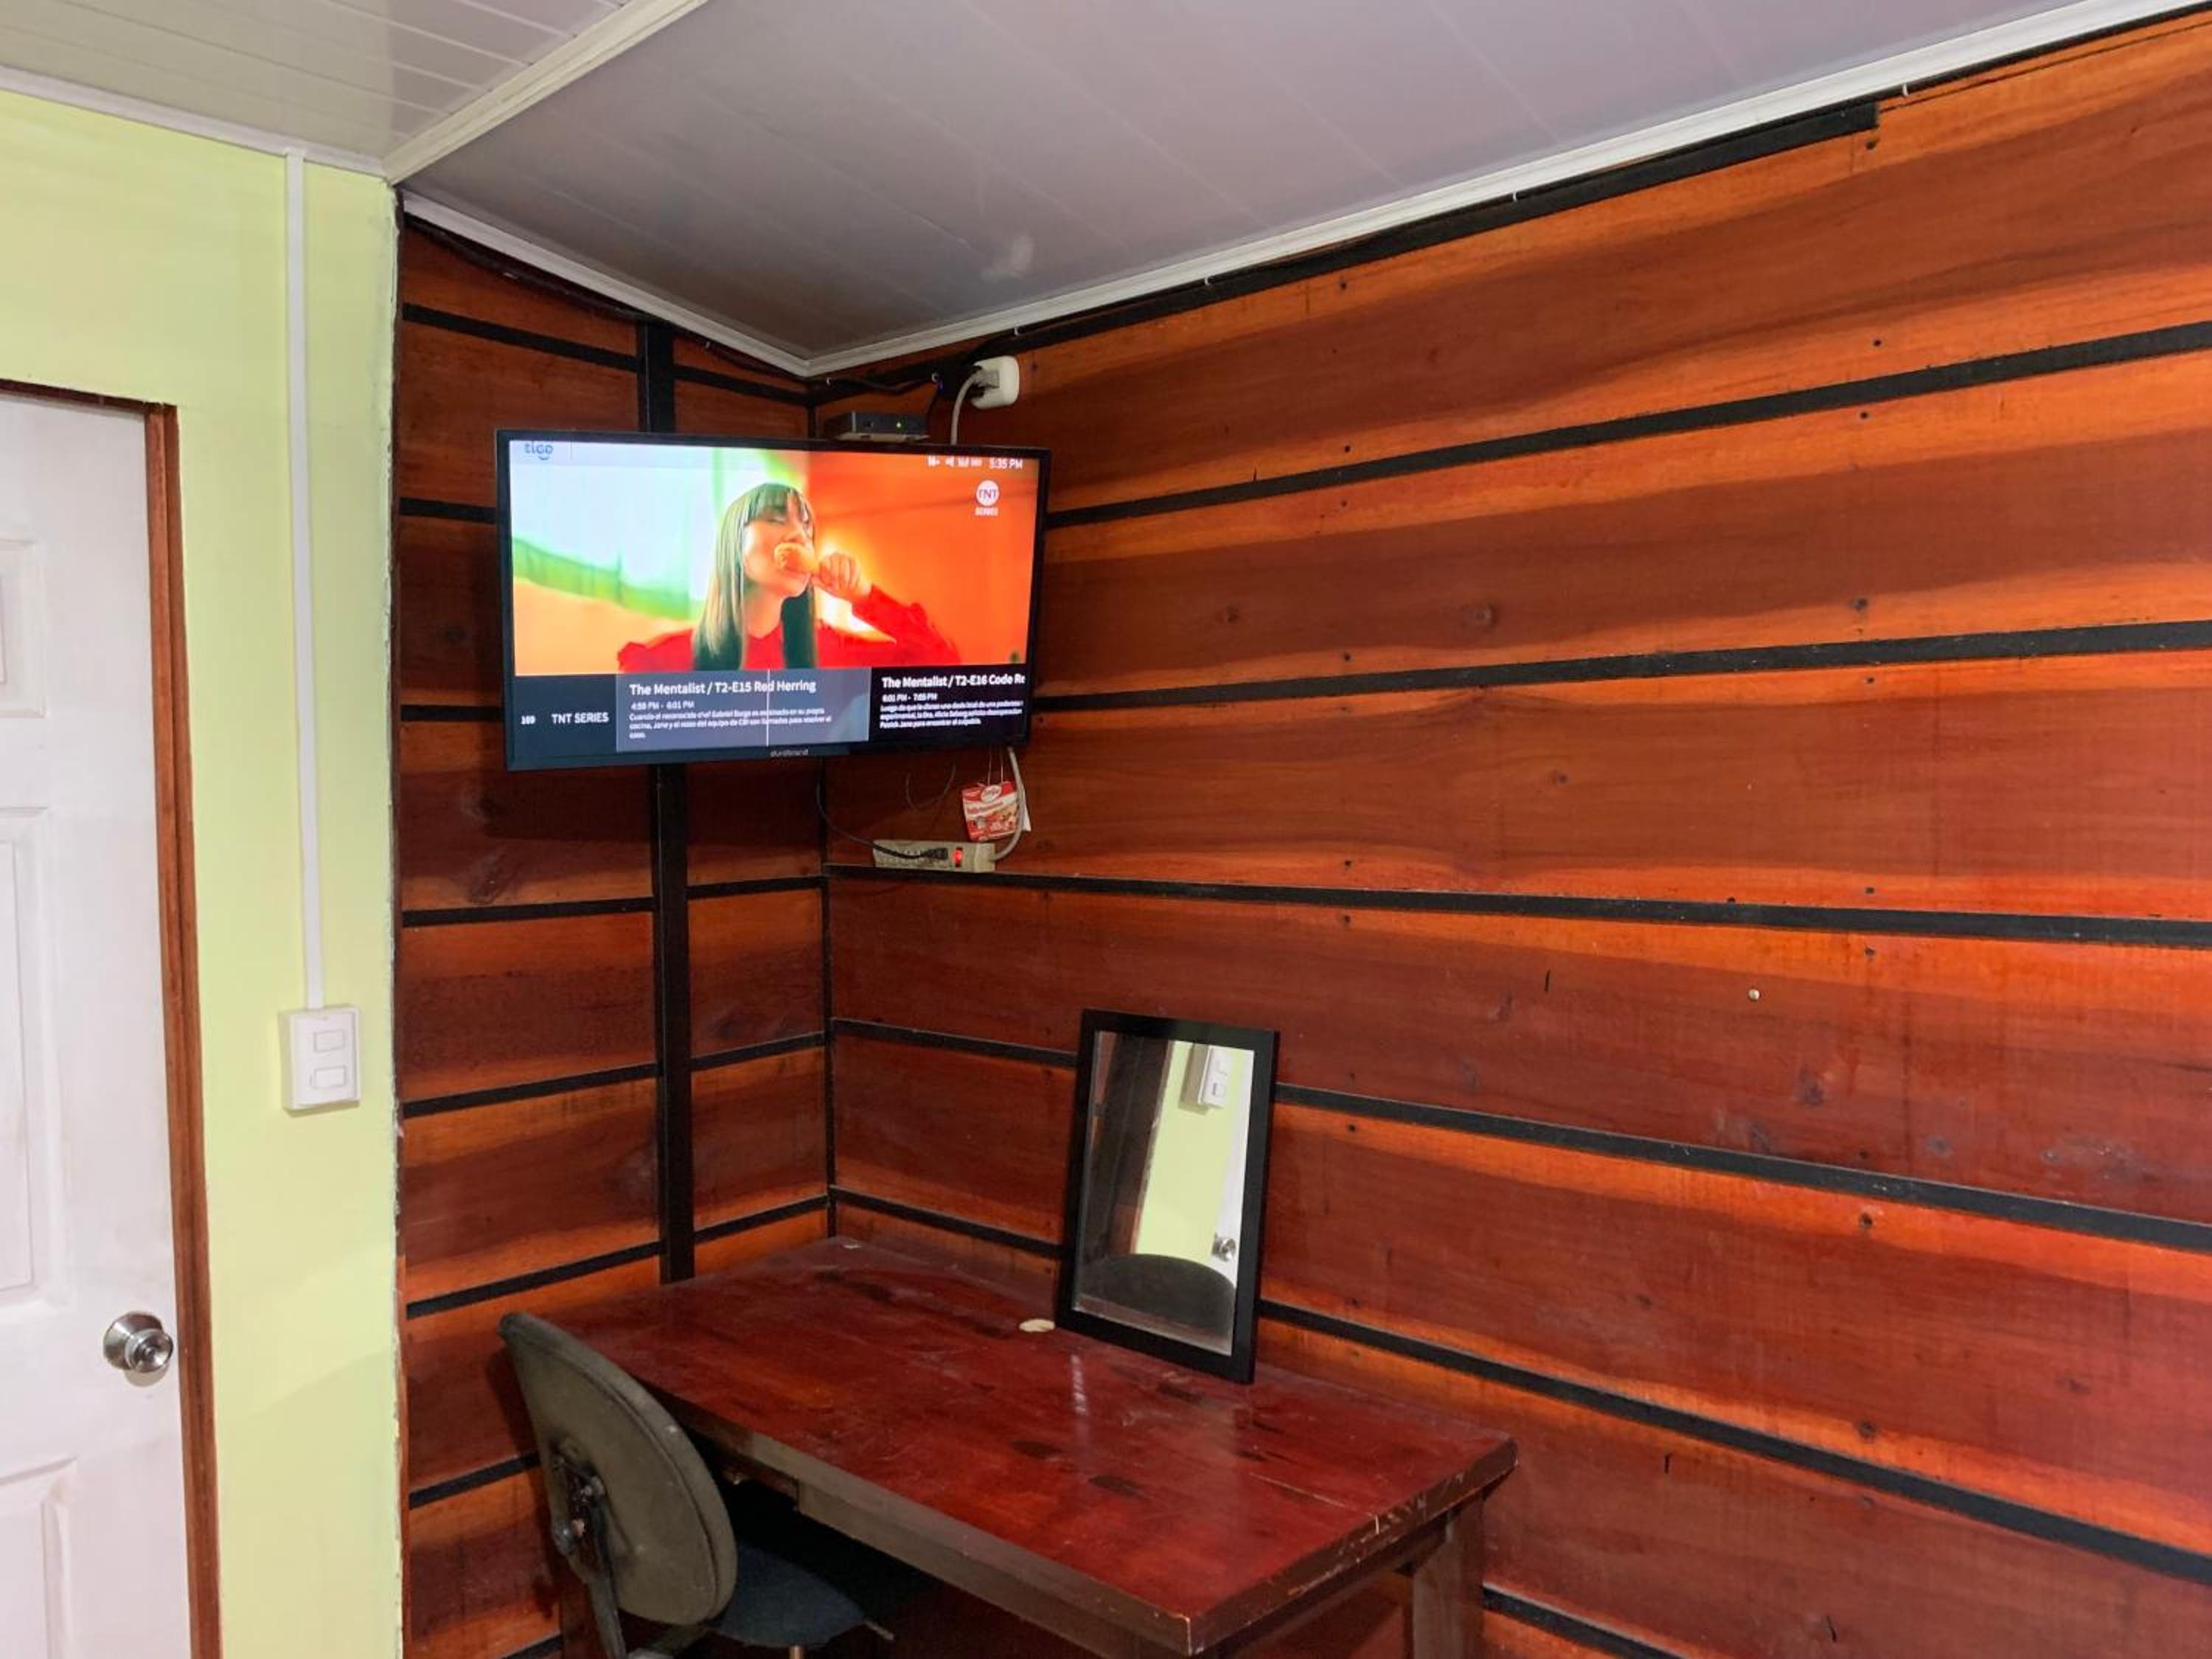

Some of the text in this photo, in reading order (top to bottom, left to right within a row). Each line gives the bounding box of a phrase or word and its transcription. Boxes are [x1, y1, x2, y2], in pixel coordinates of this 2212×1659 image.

[524, 442, 554, 460] tigo
[989, 457, 1007, 470] 5:35
[1008, 457, 1023, 470] PM
[978, 488, 997, 499] TNT
[629, 679, 817, 695] The Mentalist / T2-E15 Red Herring
[882, 676, 901, 688] The
[902, 675, 947, 688] Mentalist
[989, 673, 1013, 685] Code
[647, 701, 660, 710] PM
[682, 700, 695, 709] PM
[552, 712, 609, 725] TNT SERIES
